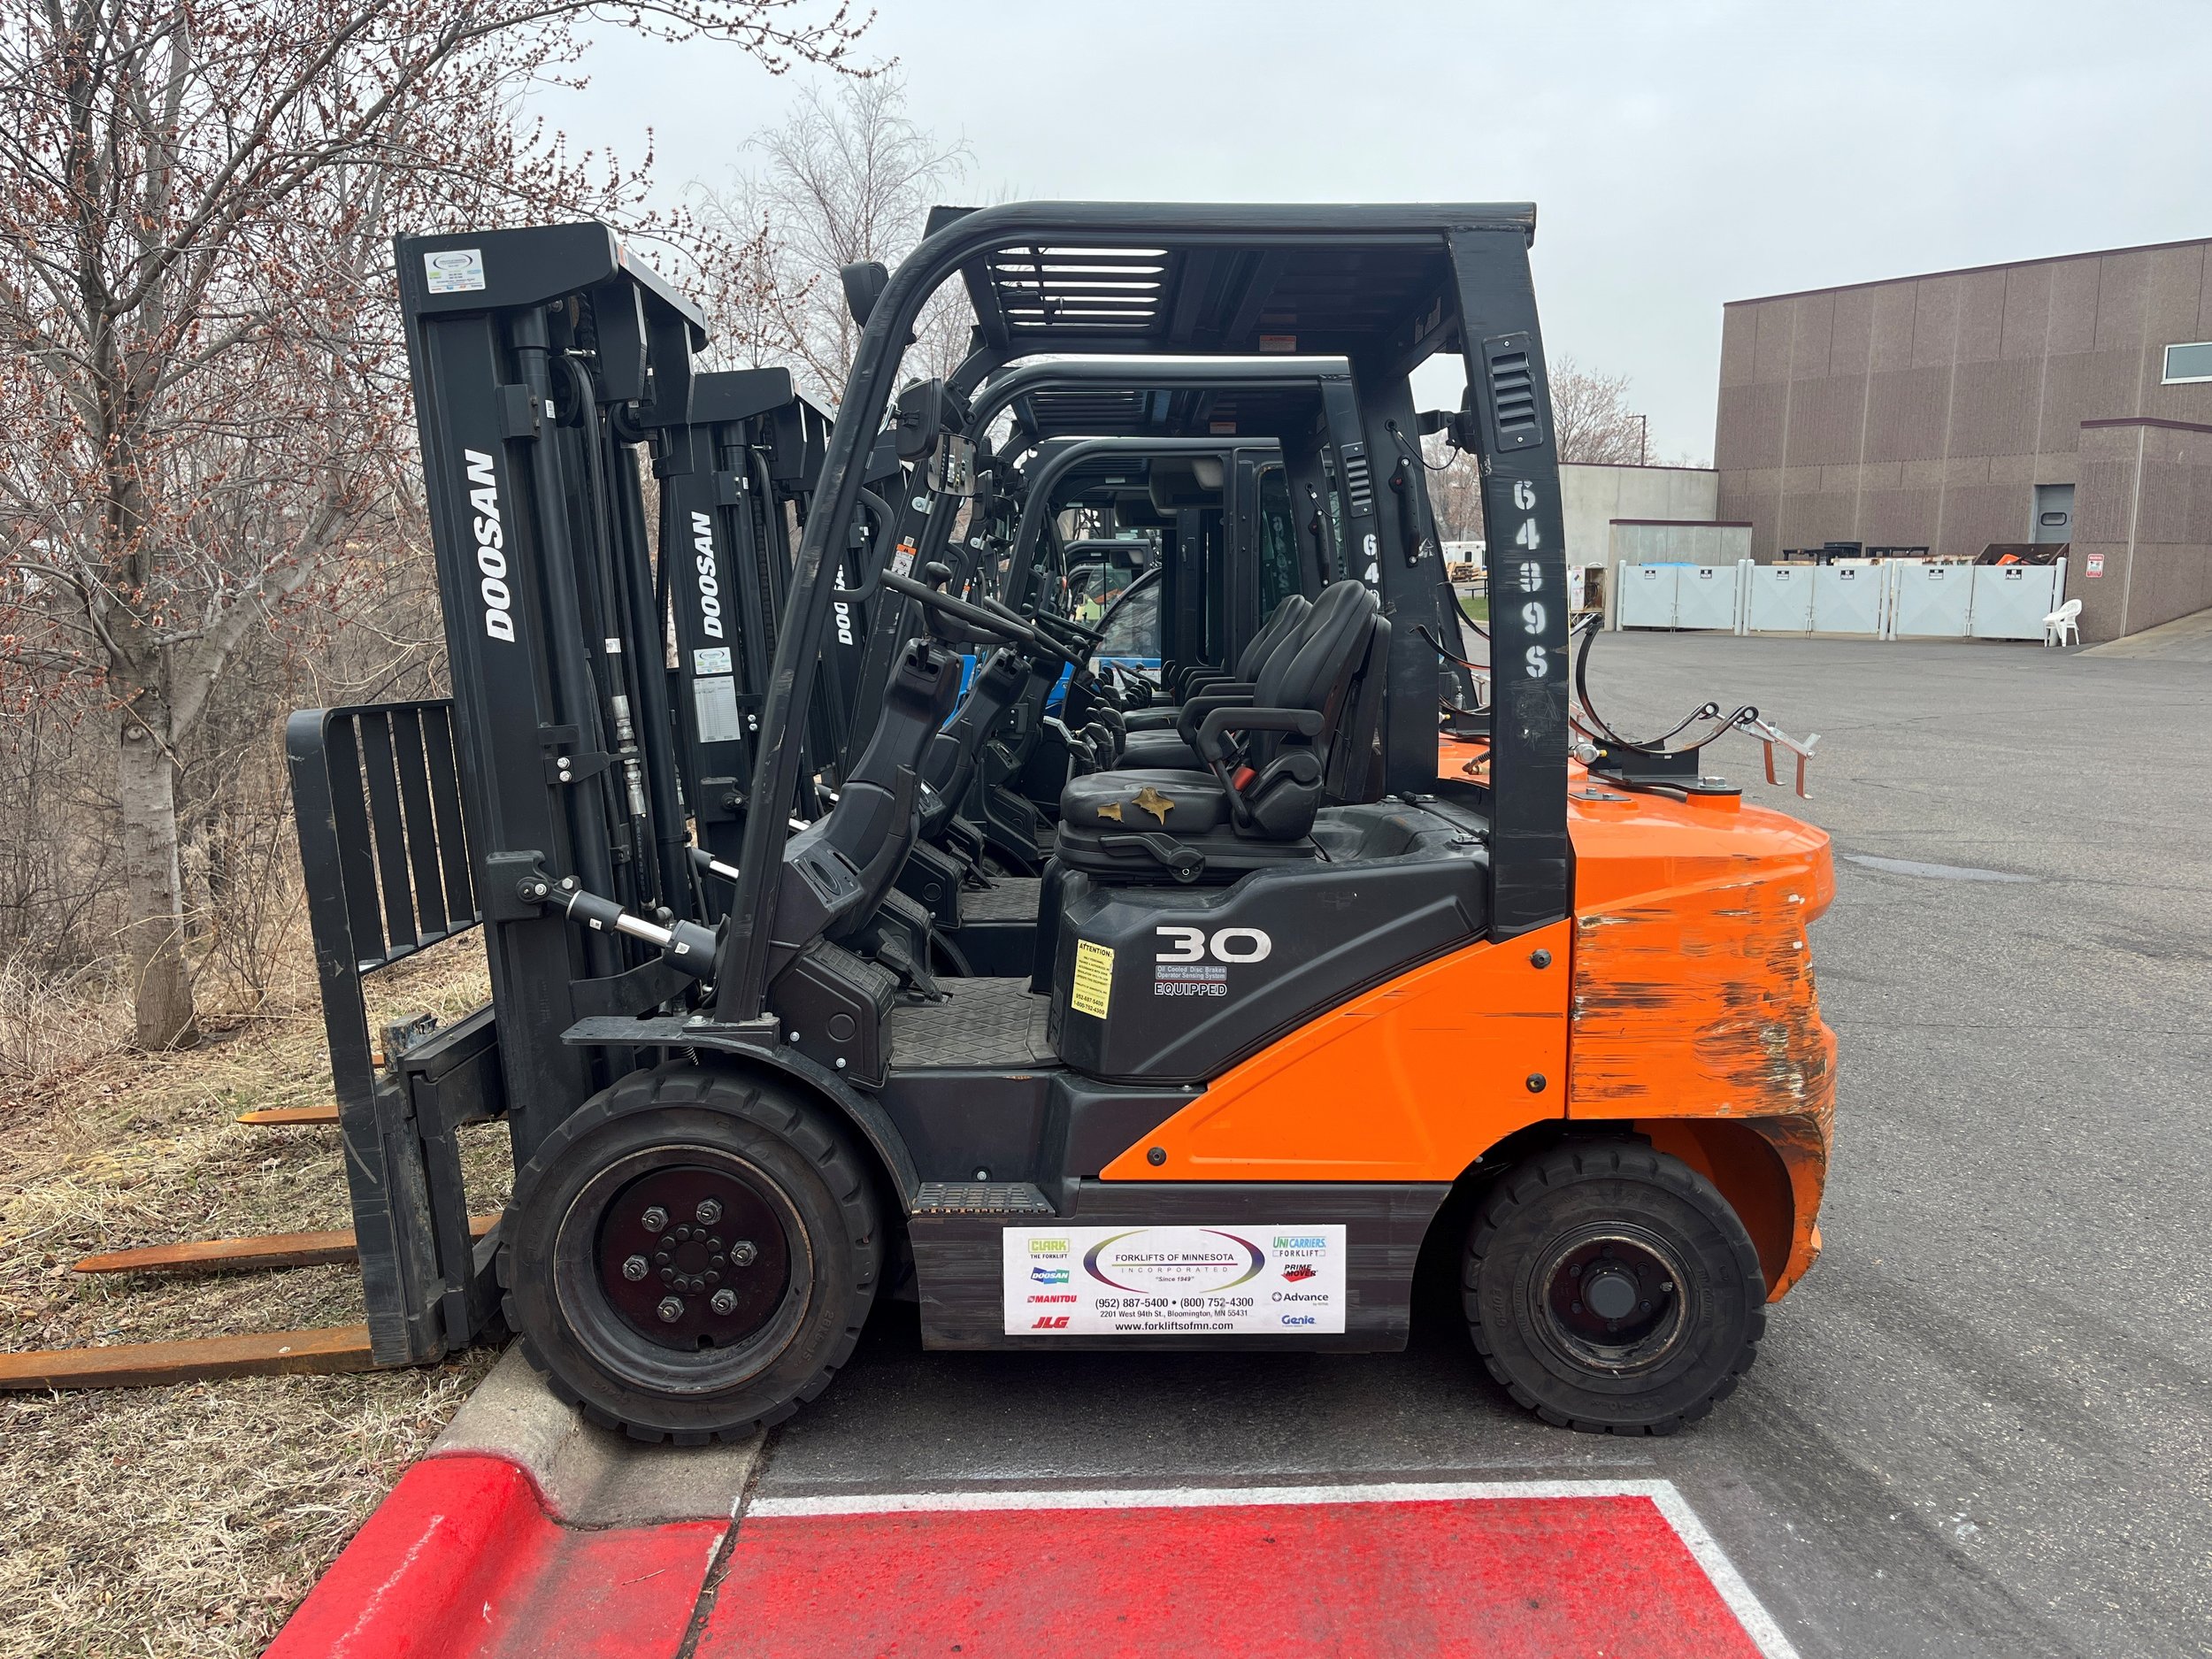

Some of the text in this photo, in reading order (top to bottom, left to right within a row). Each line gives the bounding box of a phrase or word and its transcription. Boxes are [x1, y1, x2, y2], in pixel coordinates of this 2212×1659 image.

[465, 449, 515, 642] DOOSAN
[691, 511, 723, 638] DOOSAN
[1079, 942, 1112, 958] ATTENTION:
[1156, 926, 1271, 963] 30
[1155, 983, 1227, 996] EQUIPPED
[1031, 1240, 1066, 1251] CLARK
[1095, 1297, 1254, 1310] (952) 887-5400 (800) 752-4300
[1283, 1292, 1329, 1302] Advance
[1167, 1310, 1212, 1318] Bloomington,
[1281, 1314, 1315, 1325] Genie
[1031, 1316, 1071, 1329] JLG
[1115, 1321, 1233, 1331] www.forkliftsofmn.com
